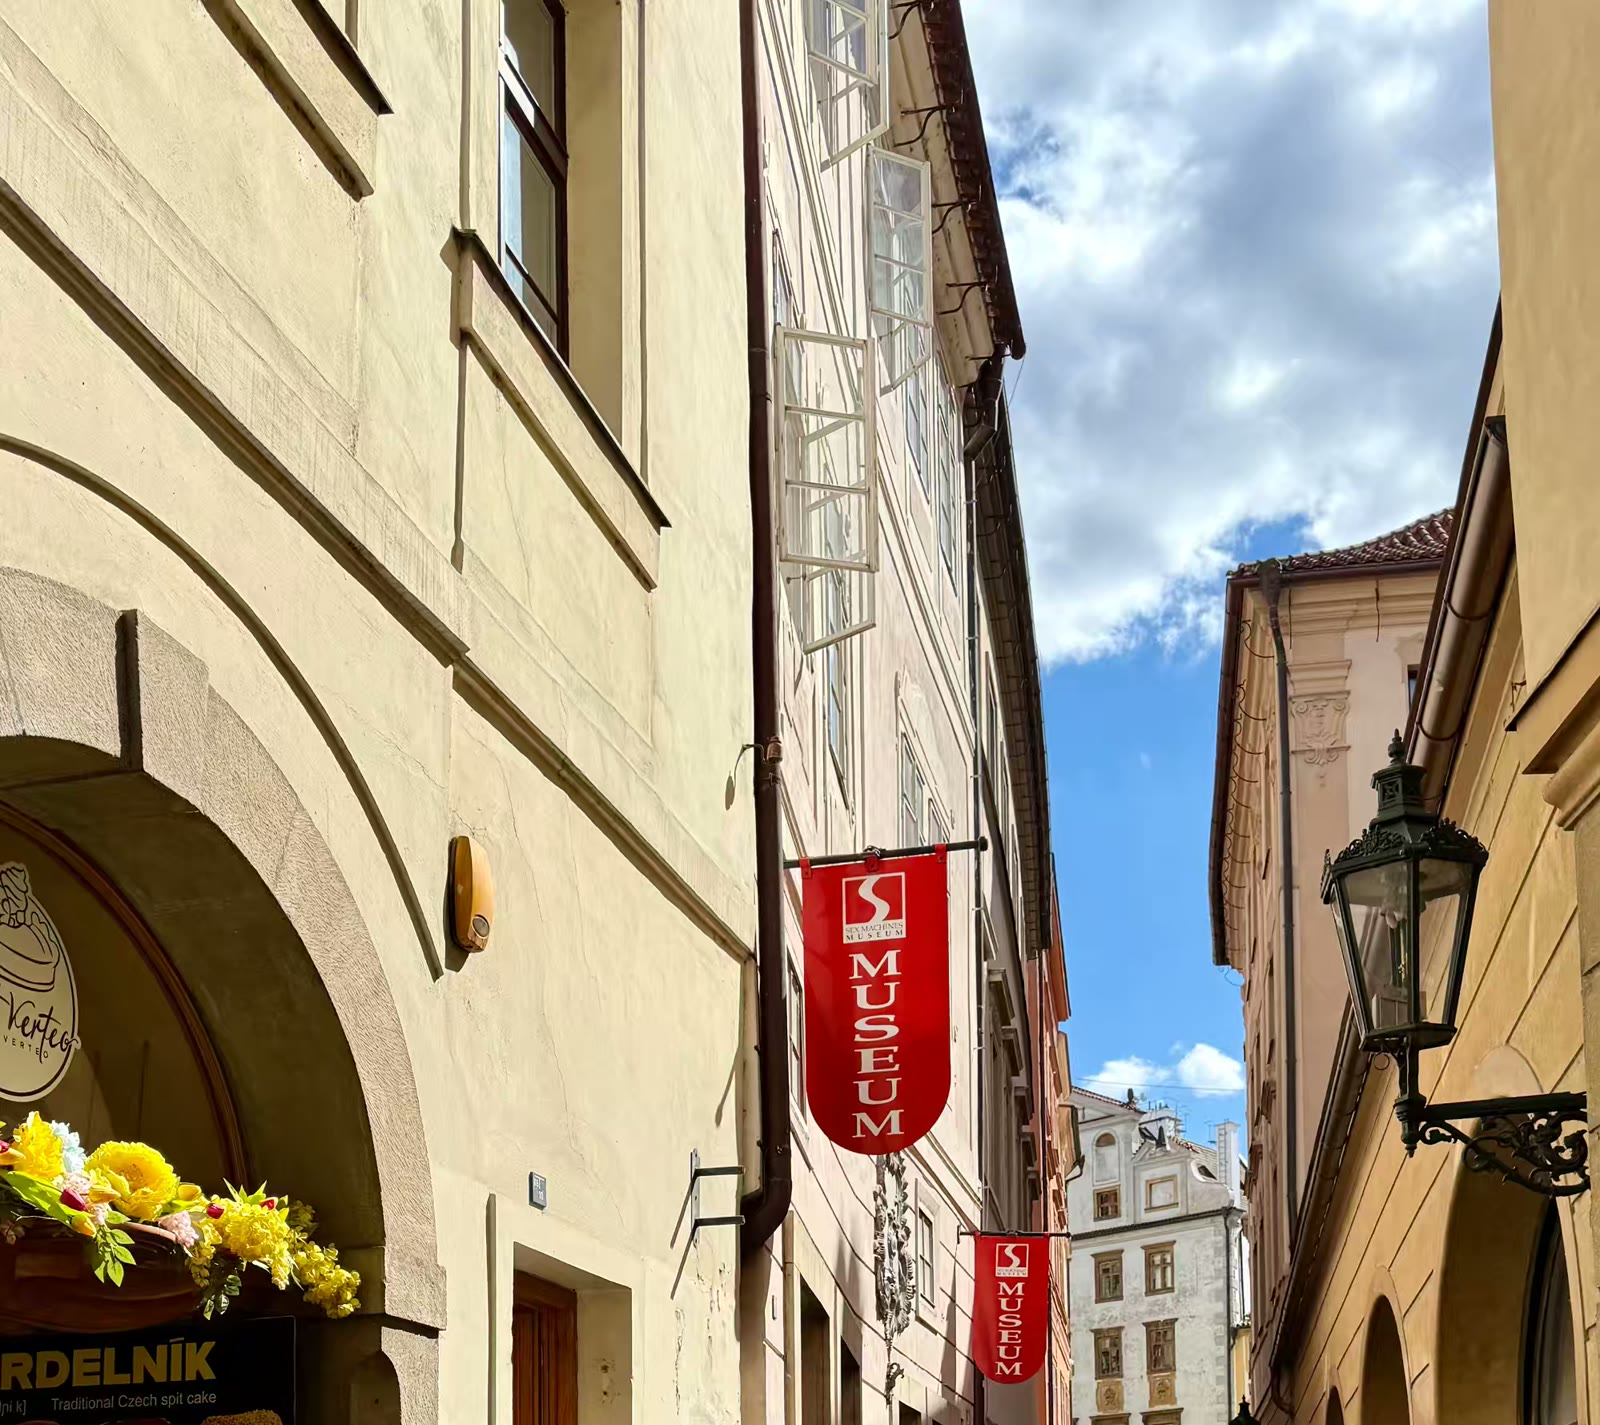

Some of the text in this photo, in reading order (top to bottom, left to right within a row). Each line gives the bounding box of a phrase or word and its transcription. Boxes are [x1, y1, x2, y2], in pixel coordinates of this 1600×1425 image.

[845, 921, 903, 934] SEX MACHINES
[846, 930, 903, 941] MUSEUM
[848, 950, 905, 1139] MUSEUM
[995, 1281, 1025, 1376] MUSEUM
[0, 1337, 217, 1390] RDELNÍK
[51, 1390, 217, 1411] Traditional Czech spit cake
